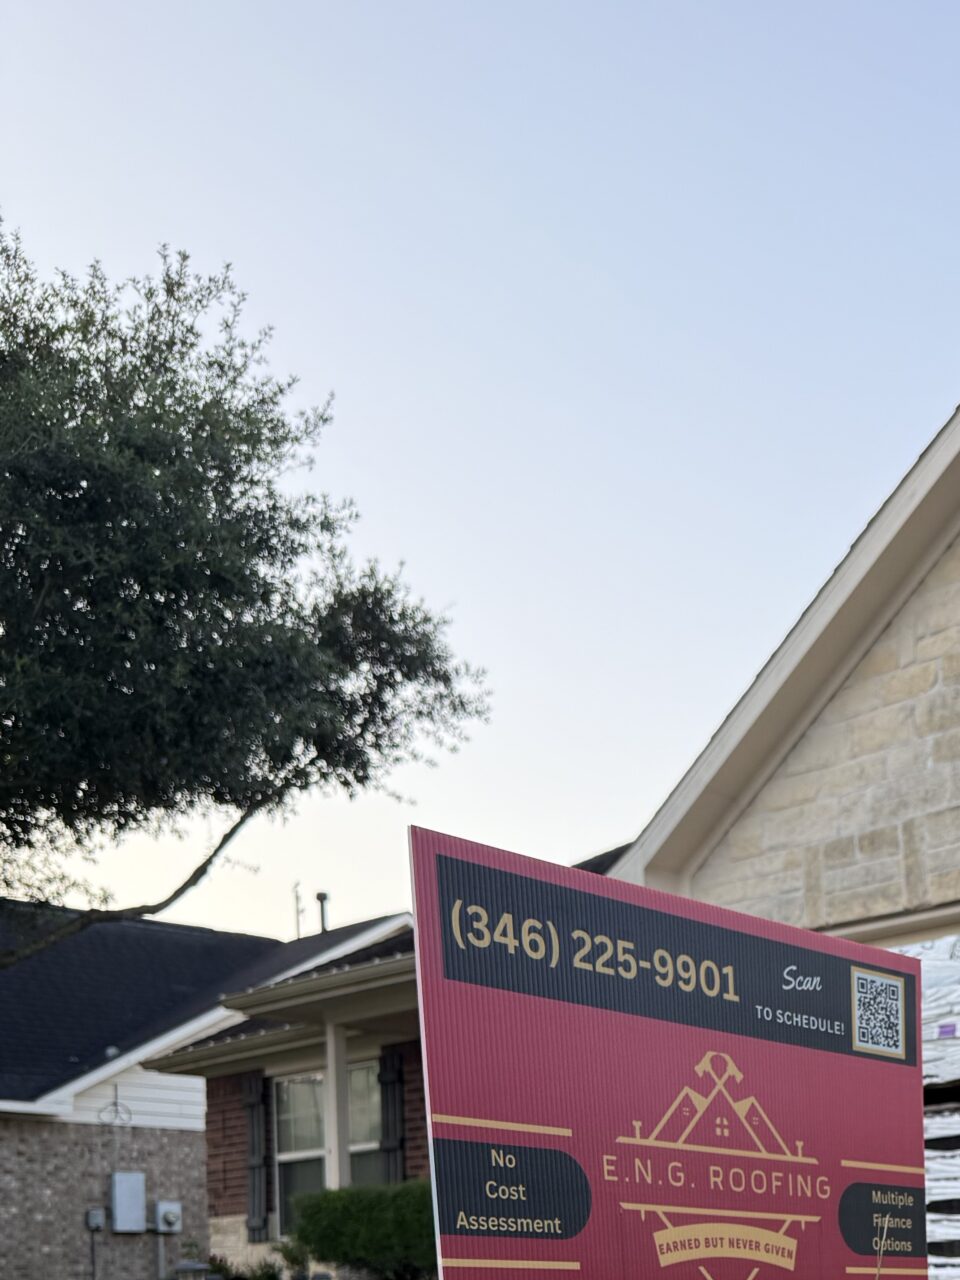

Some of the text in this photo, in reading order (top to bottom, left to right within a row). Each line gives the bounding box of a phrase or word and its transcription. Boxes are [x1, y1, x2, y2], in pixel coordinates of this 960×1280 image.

[451, 899, 740, 1002] (346) 225-9901
[782, 965, 822, 991] Scan
[755, 1005, 845, 1035] TO SCHEDULE!
[491, 1149, 516, 1168] No
[602, 1154, 831, 1199] E.N.G. ROOFING
[485, 1181, 527, 1200] Cost
[872, 1190, 914, 1208] Multiple
[456, 1211, 562, 1234] Assessment
[658, 1237, 795, 1260] EARNED BUT NEVER GIVEN
[872, 1237, 912, 1254] Options
